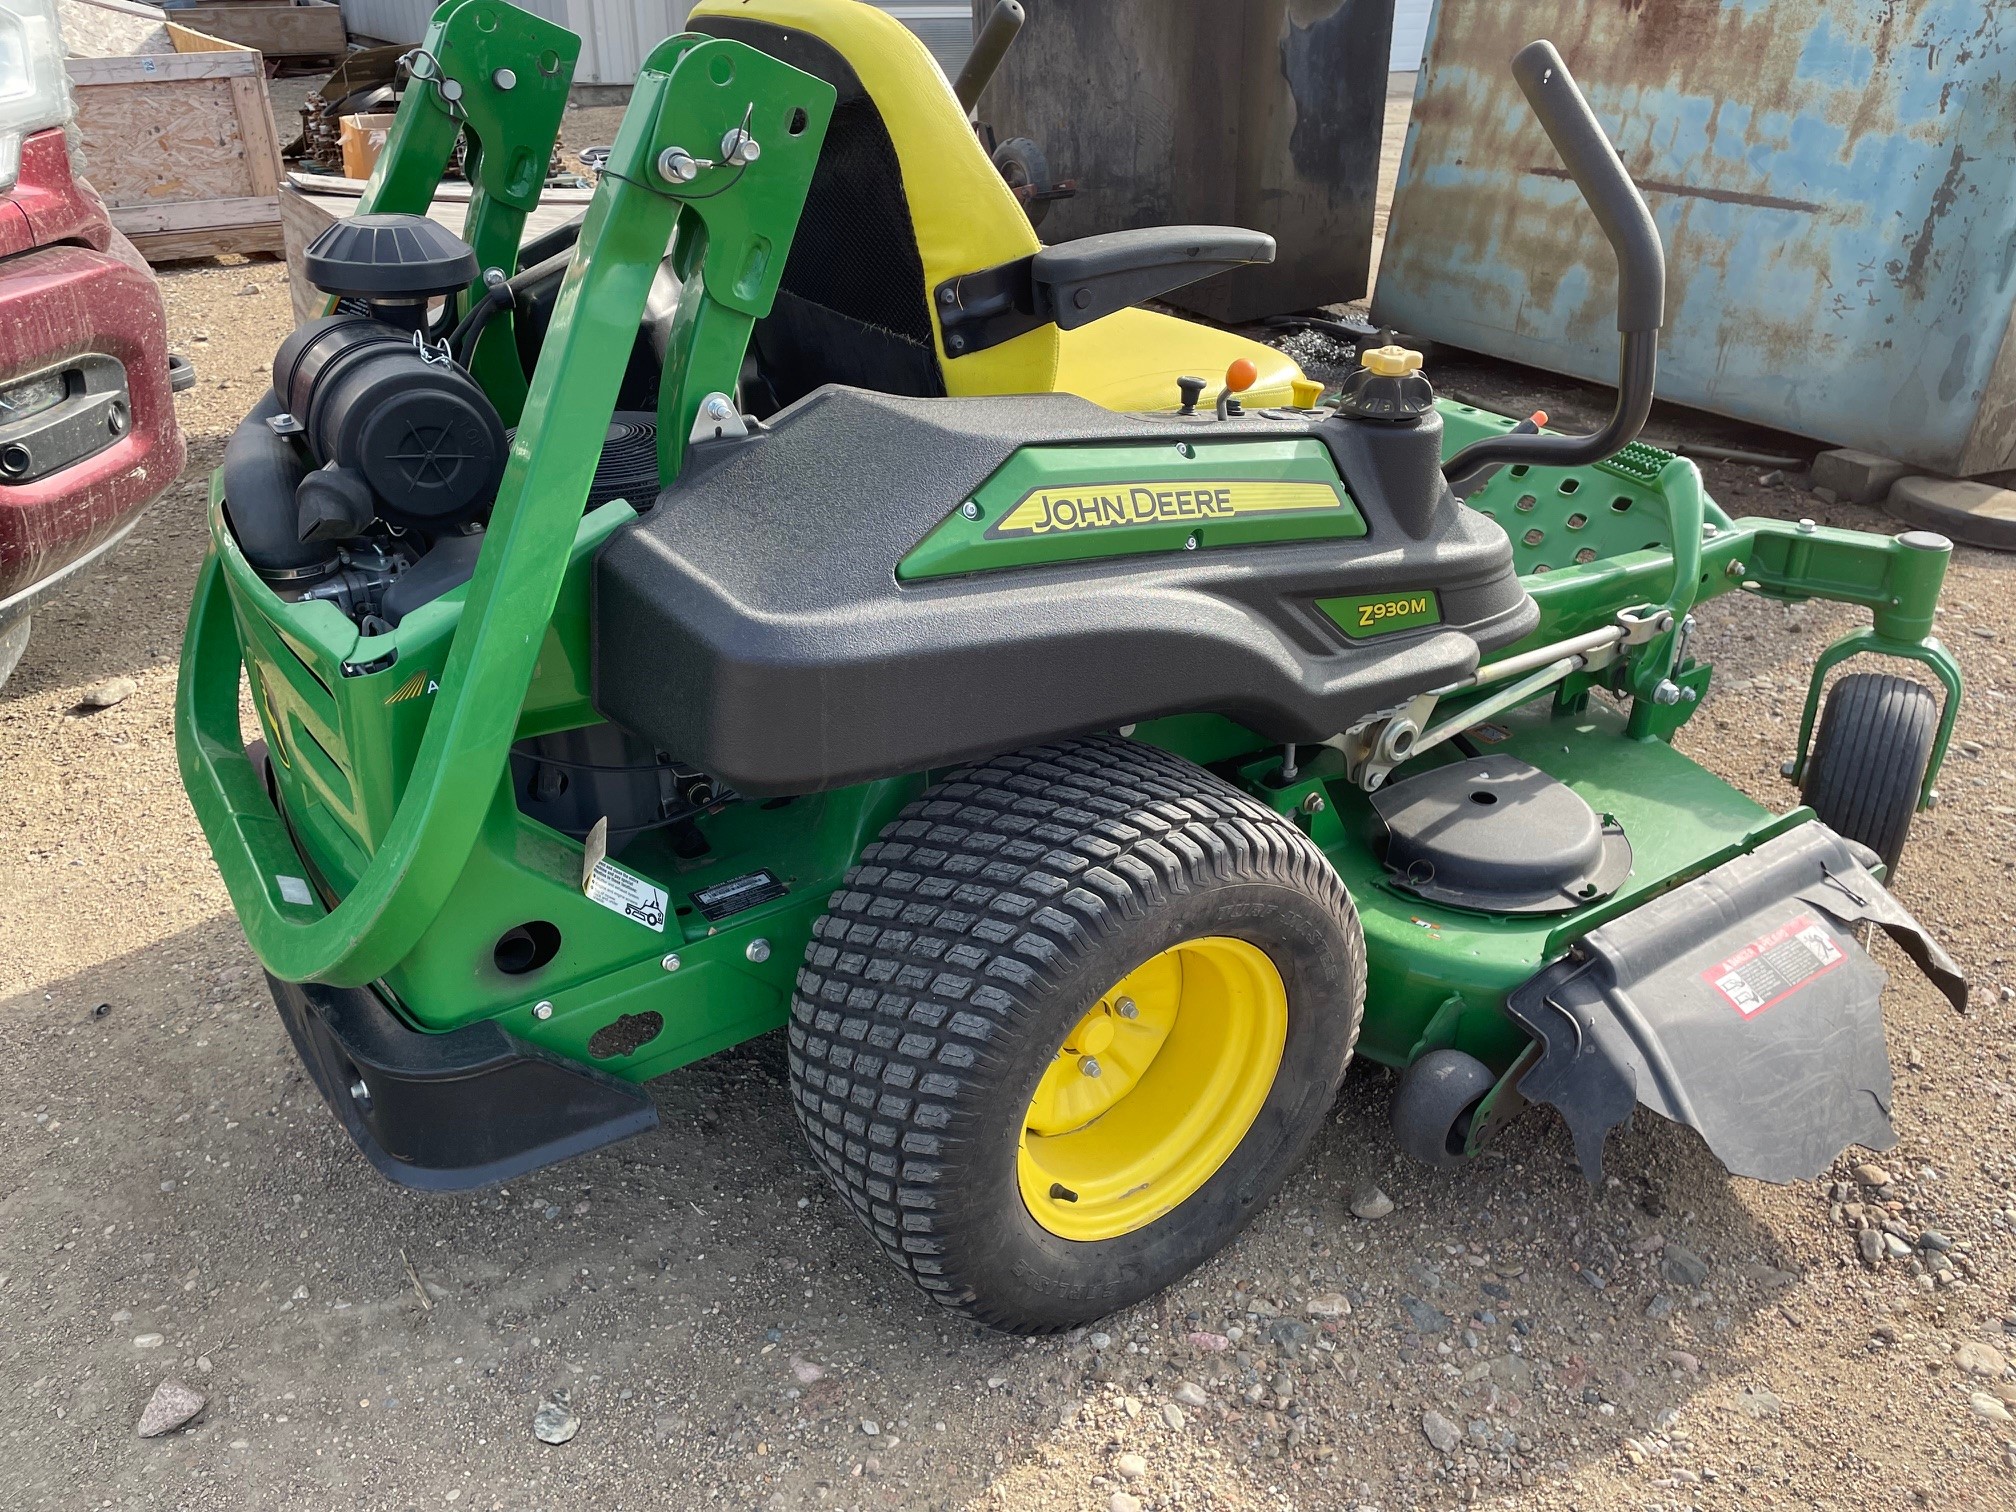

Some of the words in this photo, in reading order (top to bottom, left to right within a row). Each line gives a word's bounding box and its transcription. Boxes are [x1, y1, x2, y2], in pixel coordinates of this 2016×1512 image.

[1035, 495, 1126, 528] JOHN
[1129, 488, 1234, 518] DEERE
[1358, 598, 1426, 626] Z930M
